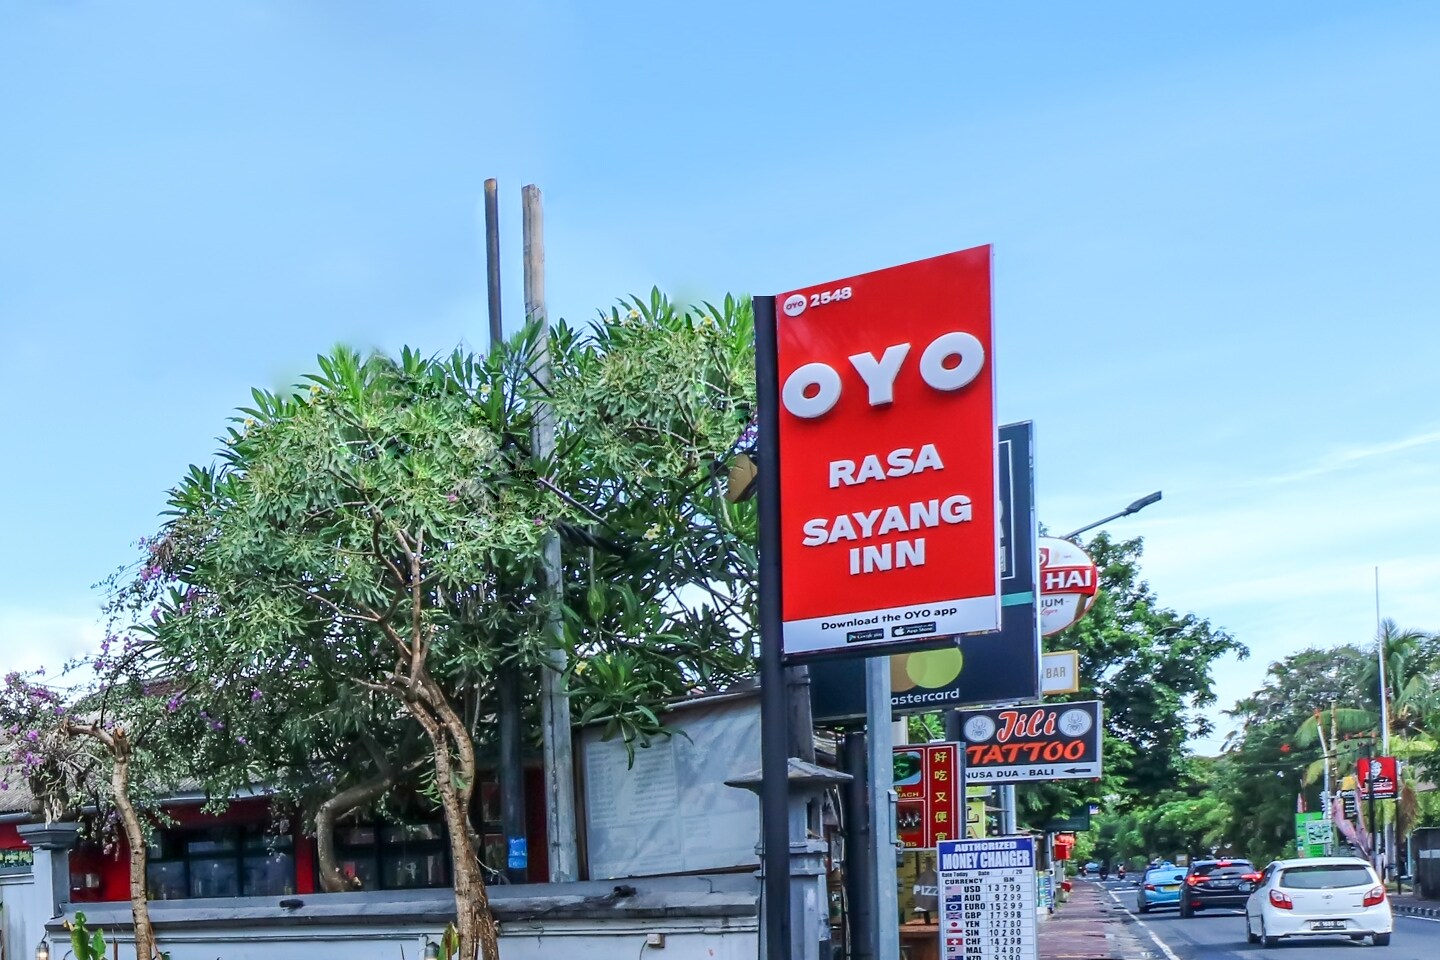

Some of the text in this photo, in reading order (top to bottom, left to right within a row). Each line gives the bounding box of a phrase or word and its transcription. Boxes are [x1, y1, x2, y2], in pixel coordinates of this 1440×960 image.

[786, 286, 852, 310] OYO 2548
[782, 331, 985, 418] OYO
[829, 443, 944, 488] RASA
[802, 495, 972, 547] SAYANG
[849, 538, 926, 576] INN
[1045, 570, 1091, 590] HAI
[821, 607, 958, 630] Download the OYO app
[1046, 666, 1066, 679] BAR
[891, 688, 960, 705] astercard
[966, 740, 1086, 765] TATTOO
[997, 770, 1019, 778] DUA
[1029, 768, 1054, 777] BALI
[954, 841, 1017, 852] AUTHORIZED
[942, 850, 1030, 870] MONEY CHANGER
[913, 884, 938, 896] PIZZ
